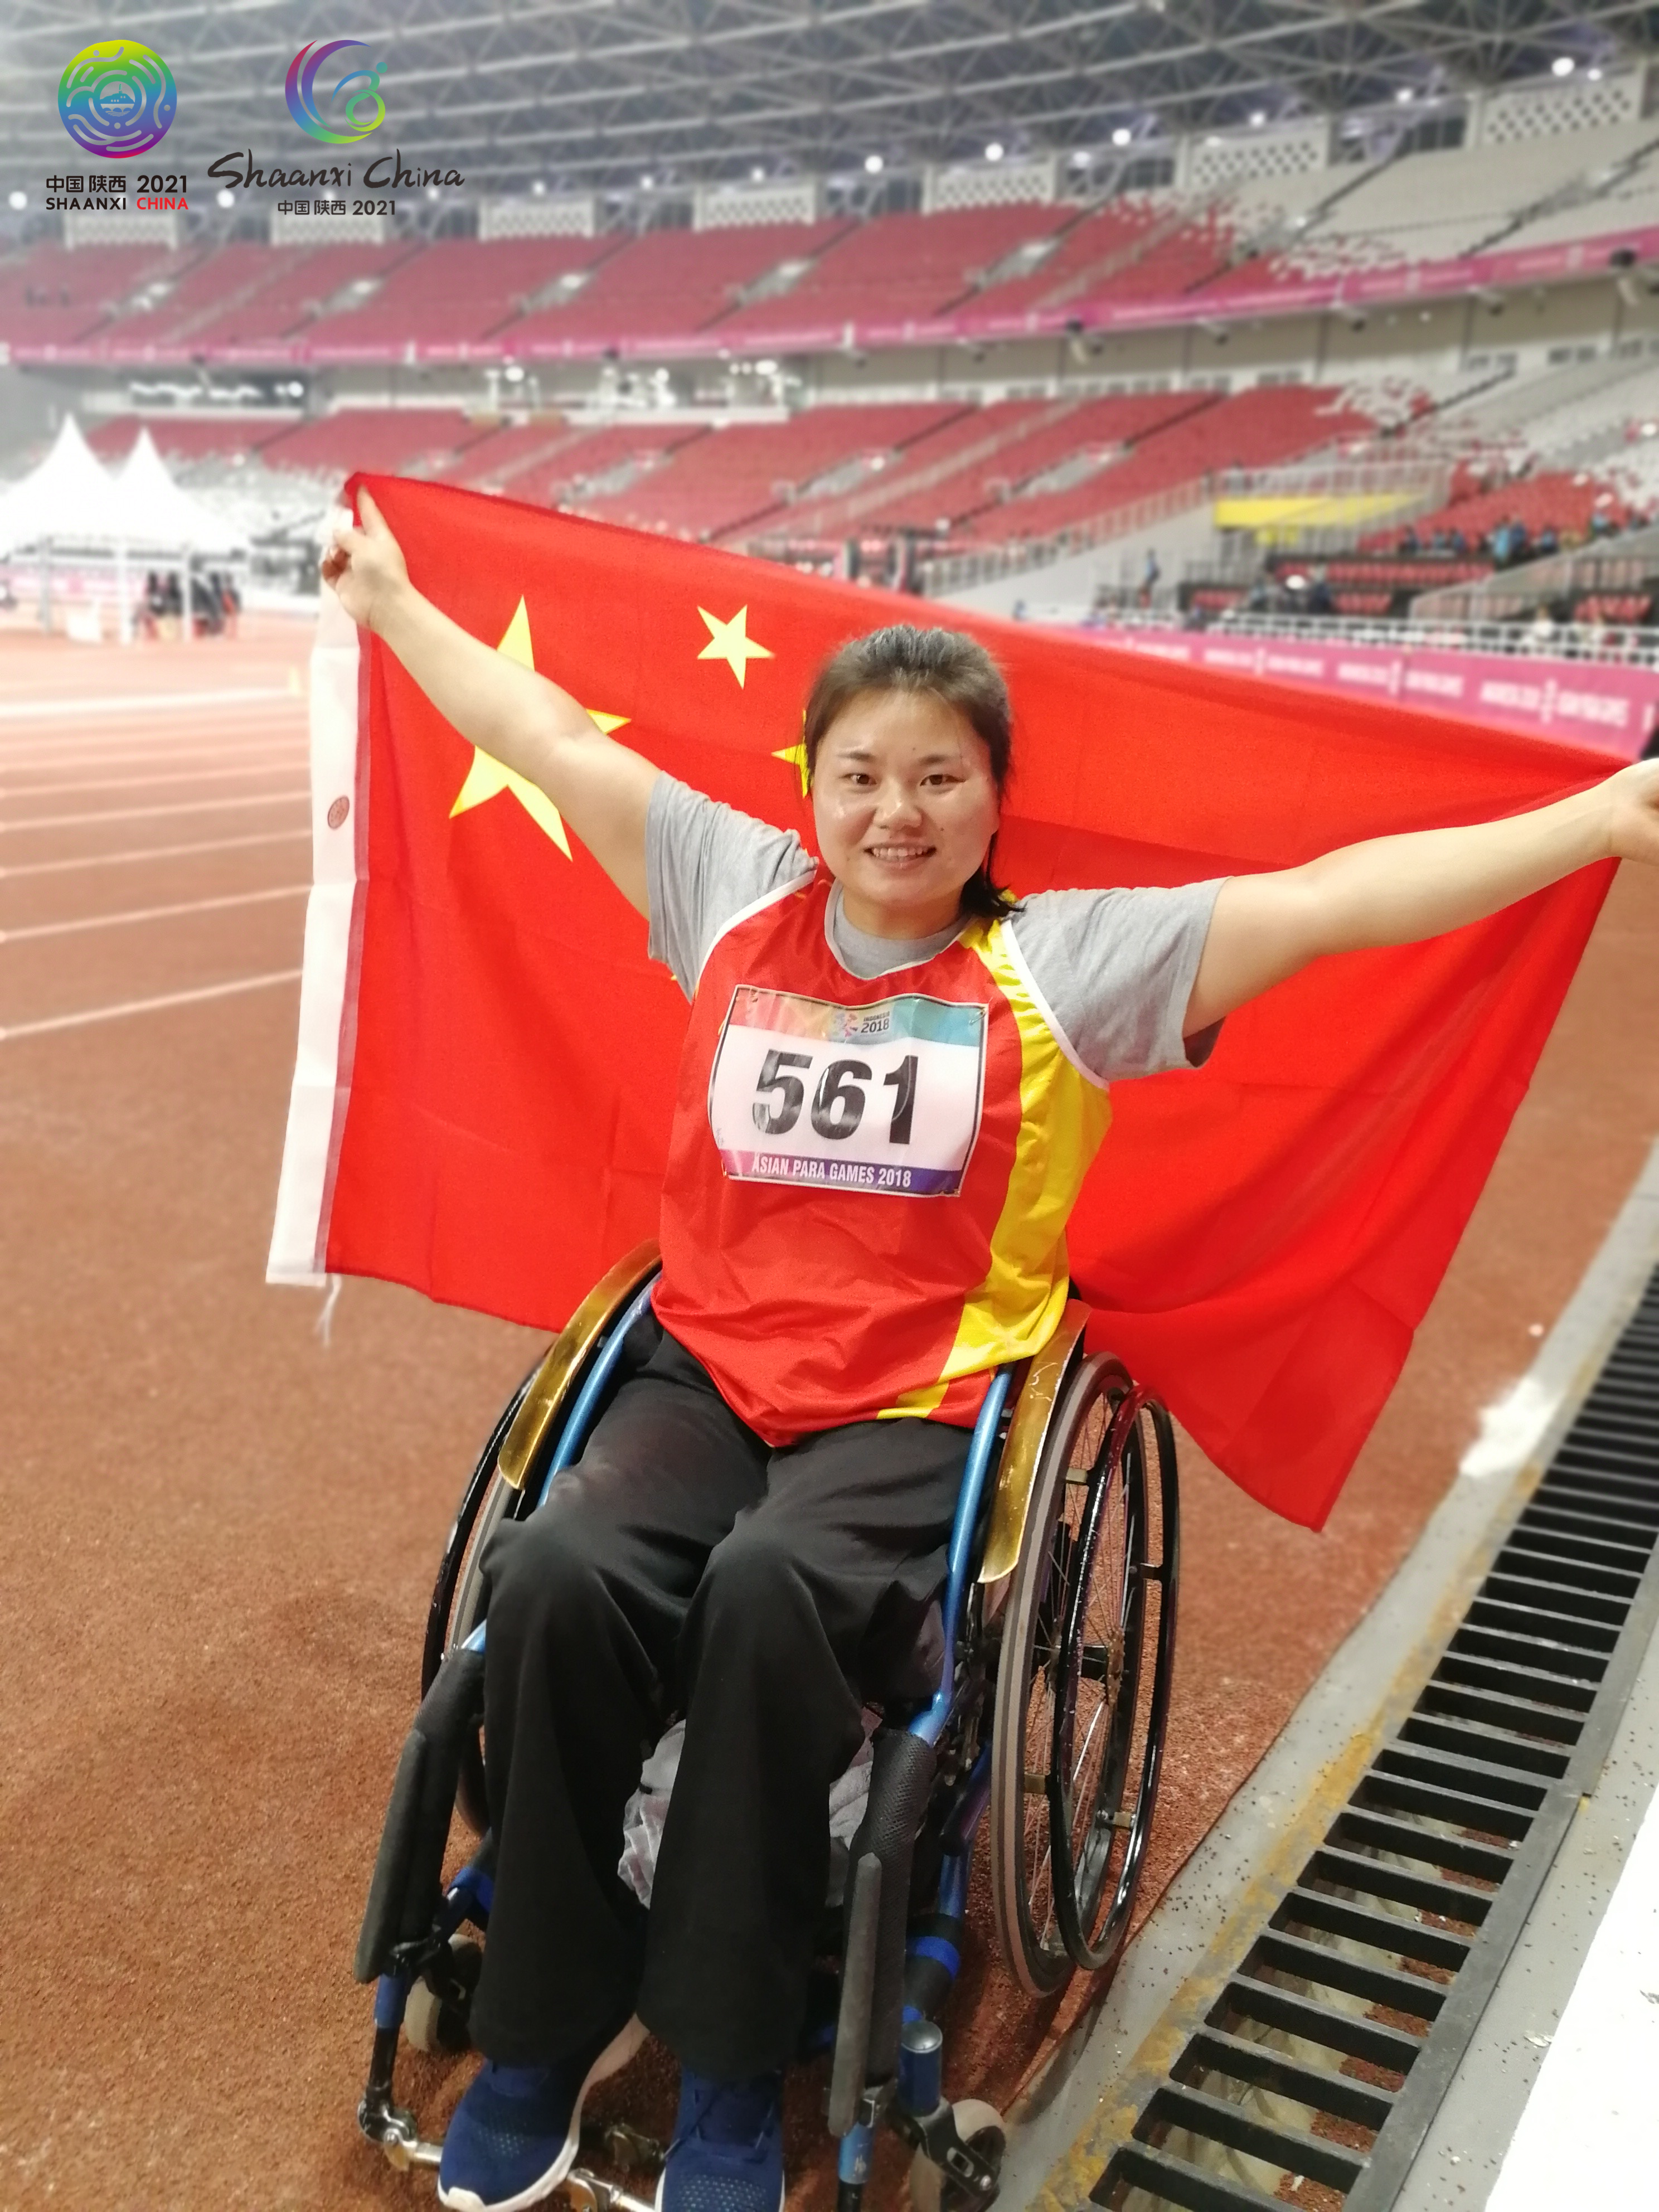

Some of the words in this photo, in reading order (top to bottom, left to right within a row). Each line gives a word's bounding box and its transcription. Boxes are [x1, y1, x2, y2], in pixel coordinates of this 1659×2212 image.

[861, 1018, 890, 1033] 2018
[752, 1049, 918, 1144] 561
[752, 1154, 789, 1176] ASIAN
[792, 1159, 825, 1178] PARA
[830, 1162, 874, 1184] GAMES
[878, 1168, 911, 1187] 2018
